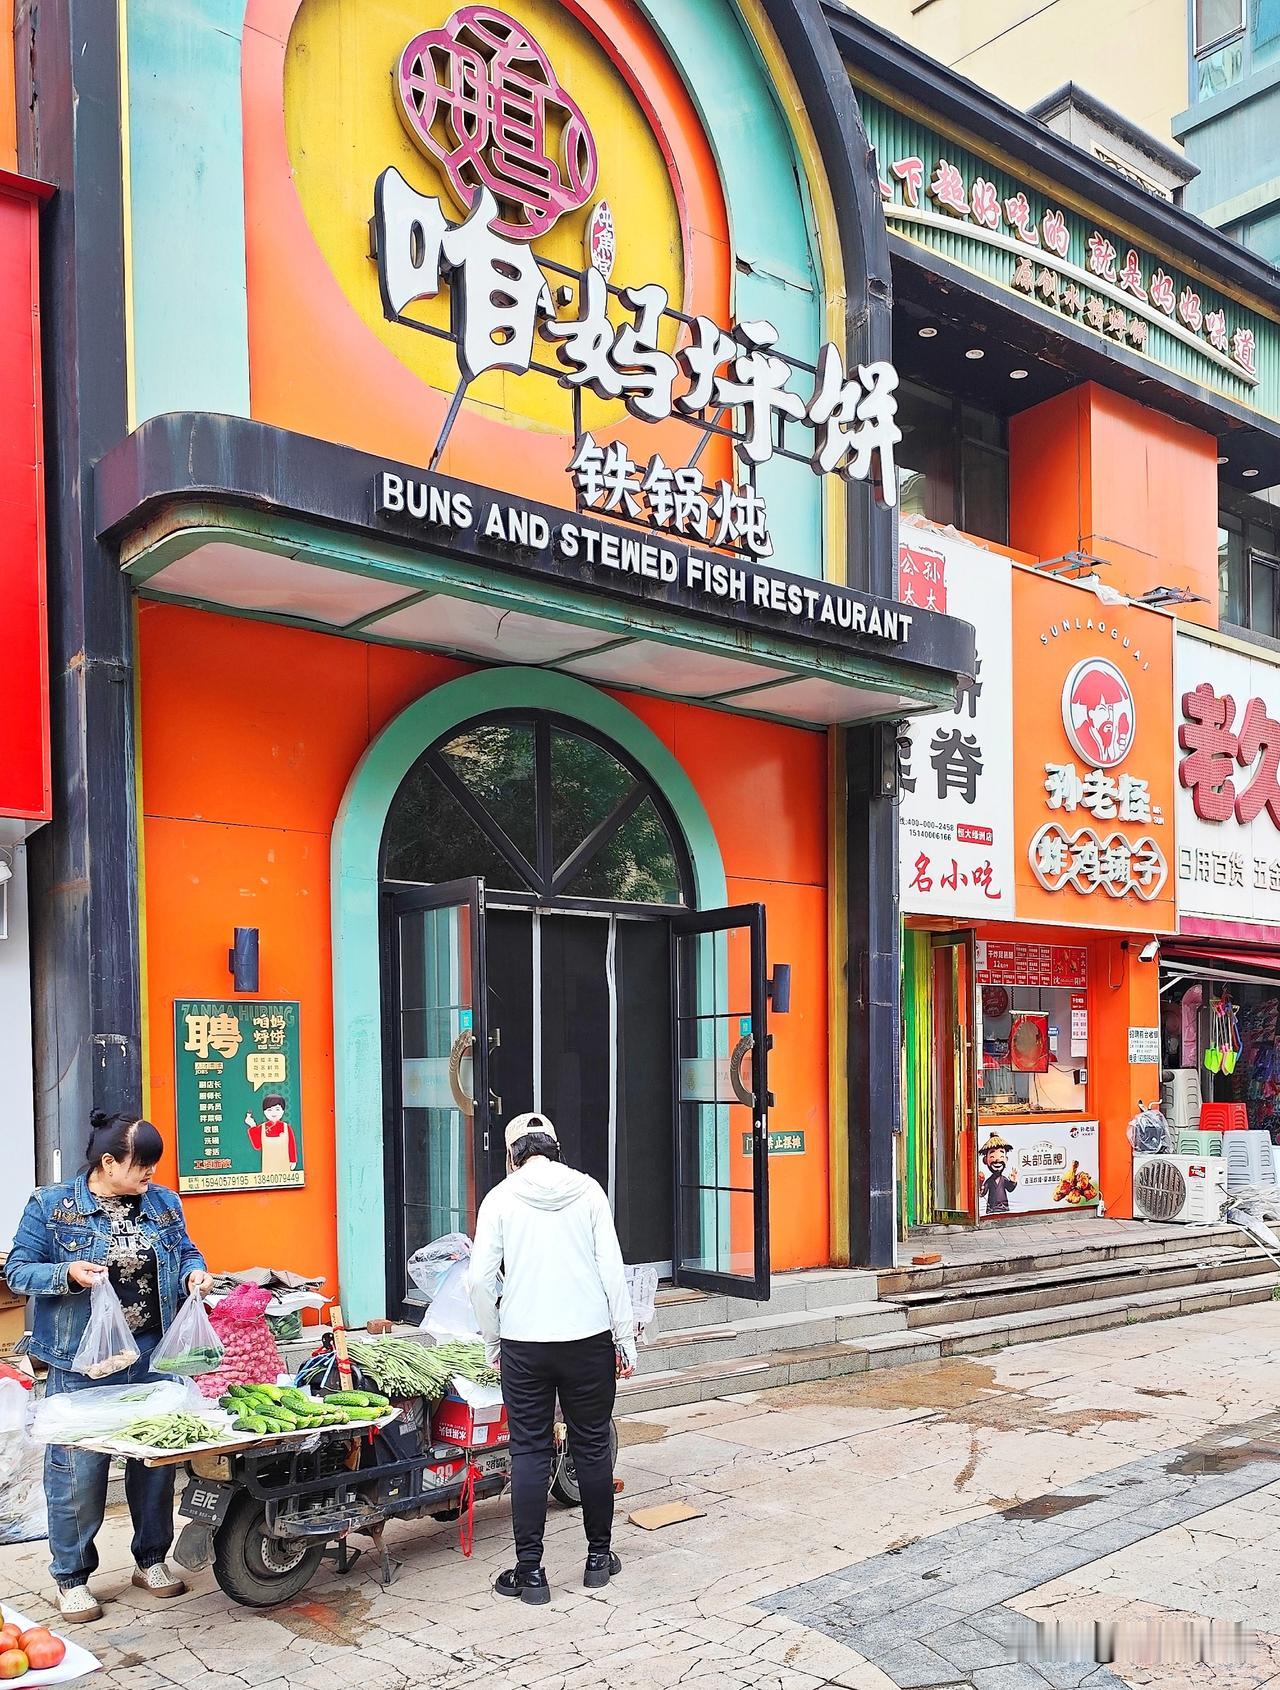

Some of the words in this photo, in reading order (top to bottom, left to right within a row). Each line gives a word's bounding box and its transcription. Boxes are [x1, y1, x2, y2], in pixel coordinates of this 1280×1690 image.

[1088, 230, 1256, 376] 就是妈妈味道
[572, 432, 774, 558] 铁锅炖
[381, 471, 474, 530] BUNS
[484, 504, 551, 552] AND
[559, 526, 678, 584] STEWED
[684, 556, 748, 604] FISH
[751, 577, 914, 645] RESTAURANT
[1040, 618, 1150, 671] SUNLAOGUAI
[1178, 682, 1280, 832] 老久
[1043, 762, 1153, 824] 孙老怪
[909, 829, 952, 841] 15140006166
[908, 851, 1001, 899] 名小吃
[1037, 834, 1162, 885] 炸鸡铺子
[1179, 846, 1245, 888] 日用百货
[184, 1013, 244, 1059] 聘
[252, 1014, 286, 1030] 咱妈
[200, 1103, 222, 1111] 服务员
[204, 1126, 219, 1134] 收银
[746, 1134, 802, 1151] 门禁止摆摊
[1021, 1153, 1063, 1168] 头部品牌
[201, 1175, 249, 1188] 15940579195
[253, 1172, 300, 1185] 13840079449
